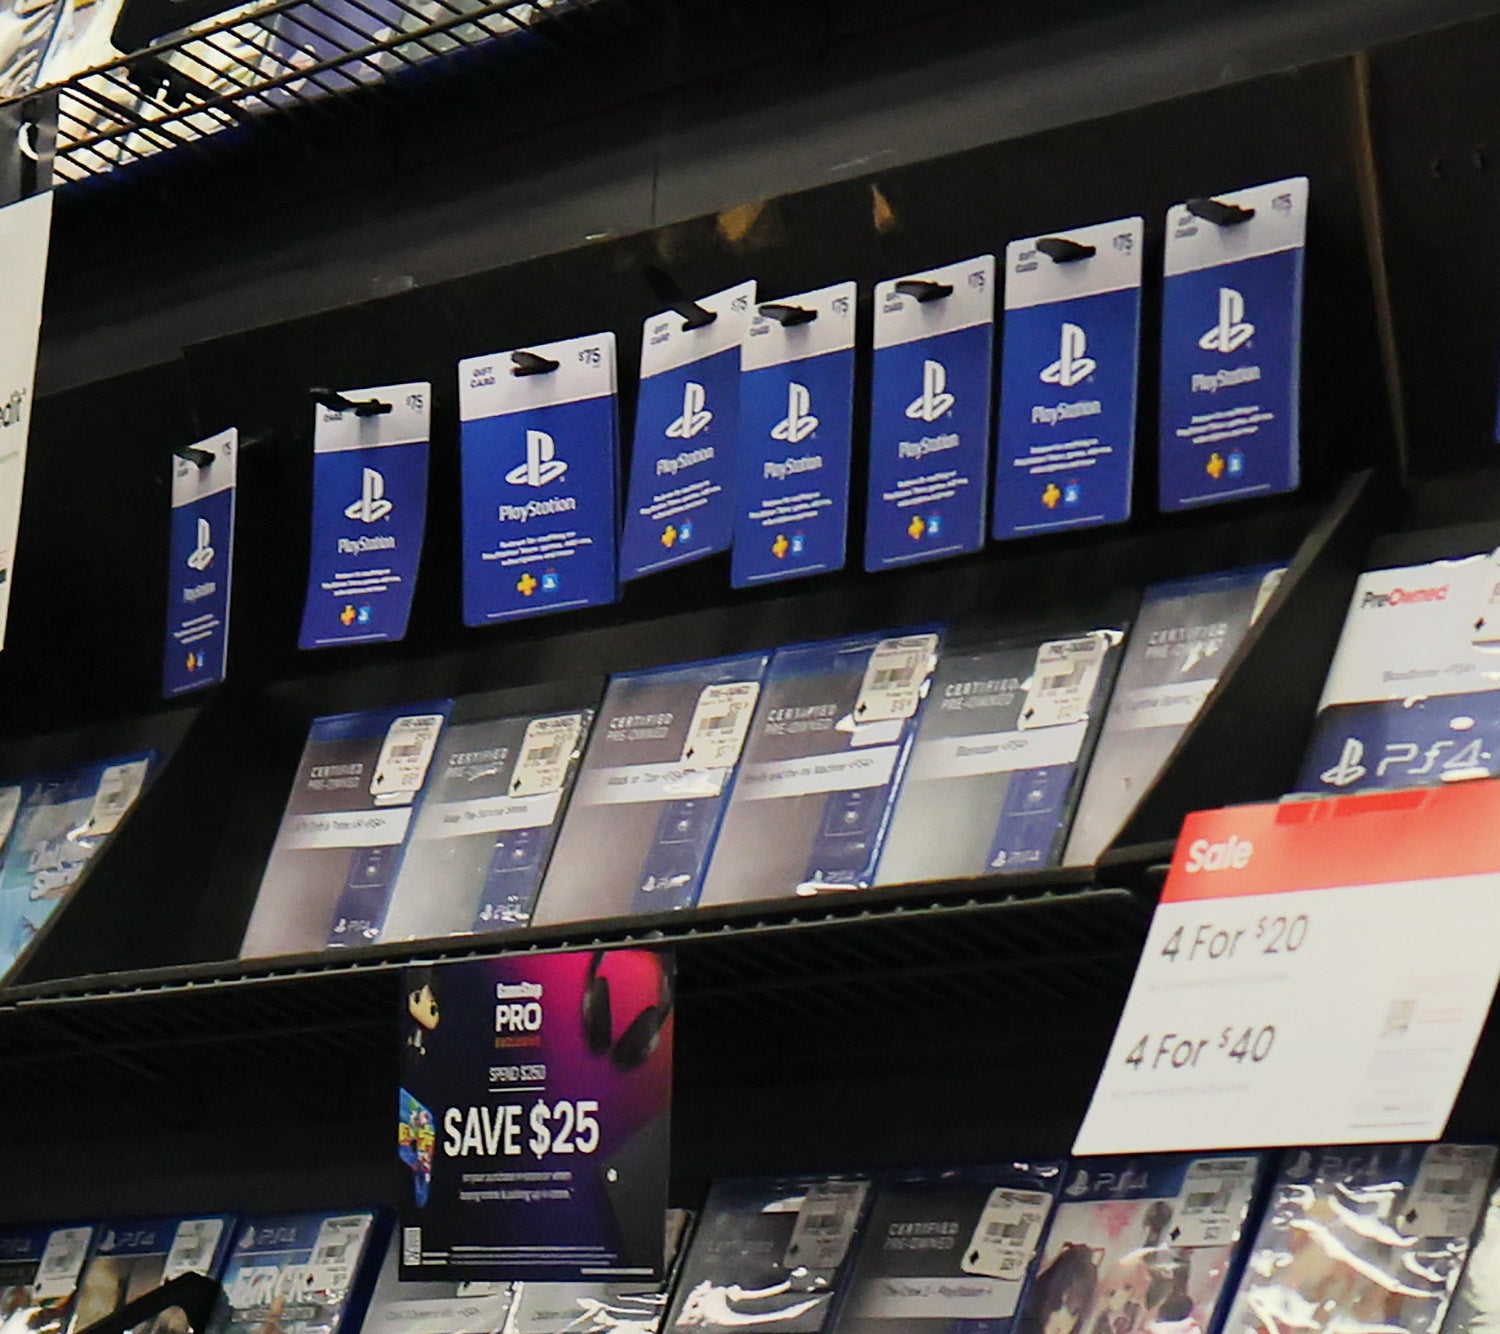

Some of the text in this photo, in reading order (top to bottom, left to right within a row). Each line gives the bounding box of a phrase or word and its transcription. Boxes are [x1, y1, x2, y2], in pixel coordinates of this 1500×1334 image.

[499, 495, 576, 523] PlayStation
[1185, 835, 1254, 874] Sale
[1161, 913, 1311, 962] 4 For $20
[495, 1002, 543, 1032] PRO
[1125, 1025, 1277, 1070] 4 For $40
[444, 1098, 600, 1160] SAVE $25
